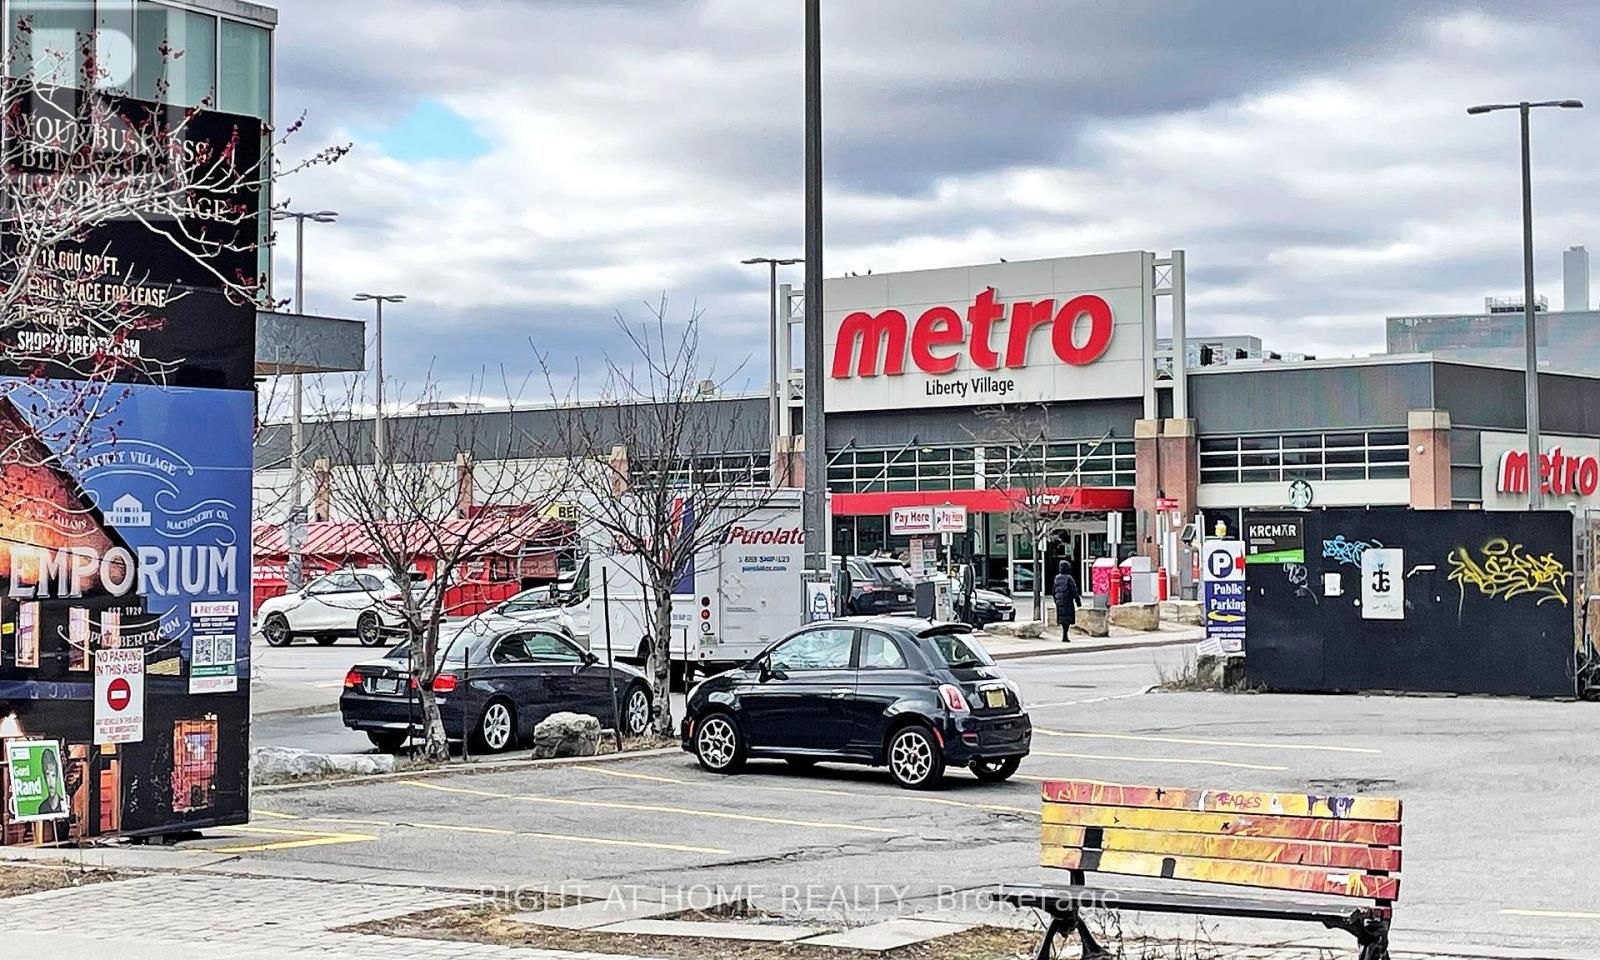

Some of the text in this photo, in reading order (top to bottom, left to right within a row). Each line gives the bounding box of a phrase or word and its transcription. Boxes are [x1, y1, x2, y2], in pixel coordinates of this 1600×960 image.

[94, 124, 208, 163] BUSESS
[131, 286, 166, 307] LEASE
[832, 286, 1113, 379] metro
[926, 376, 1014, 398] Liberty Village
[129, 451, 176, 476] VILLAGE
[895, 511, 930, 526] Pay Here
[8, 546, 239, 599] EMPORIUM
[1213, 583, 1243, 595] Public
[1210, 598, 1246, 613] Parking
[96, 649, 142, 662] NO PARKING
[105, 664, 121, 676] THIS
[123, 662, 143, 674] AREA
[15, 776, 42, 796] Rand
